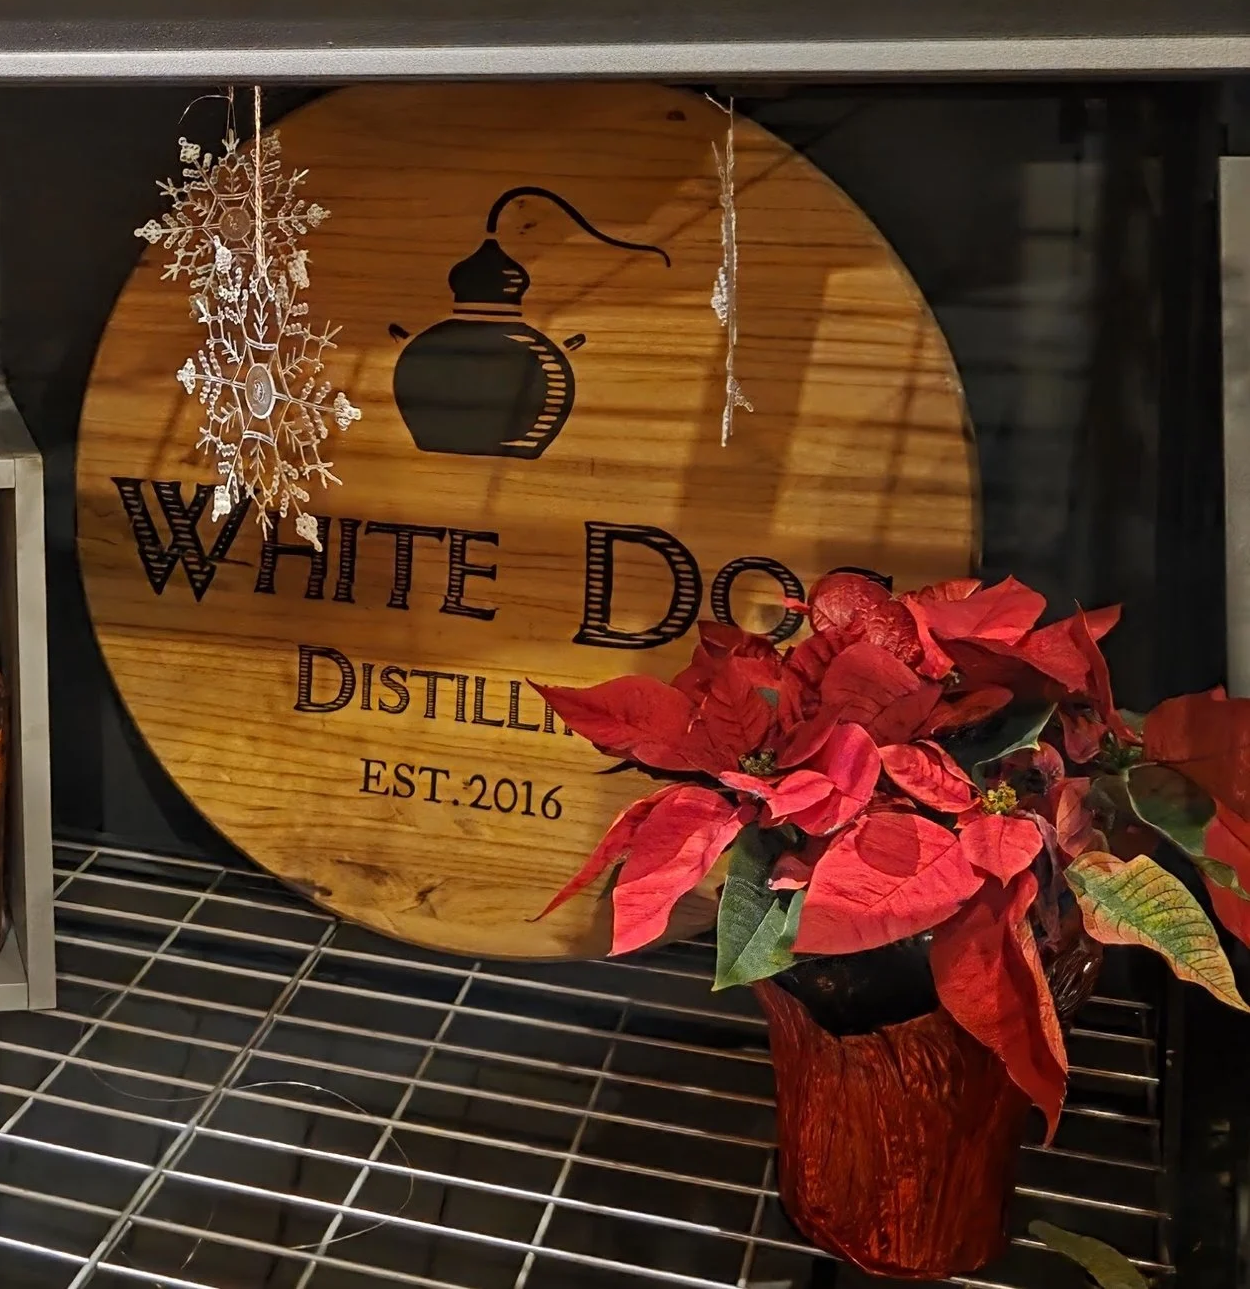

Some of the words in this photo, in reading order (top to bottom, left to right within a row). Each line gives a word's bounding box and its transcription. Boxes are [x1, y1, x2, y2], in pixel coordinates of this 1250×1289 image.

[111, 476, 499, 621] WHITE
[573, 521, 893, 649] DO
[294, 644, 573, 737] DISTILLI
